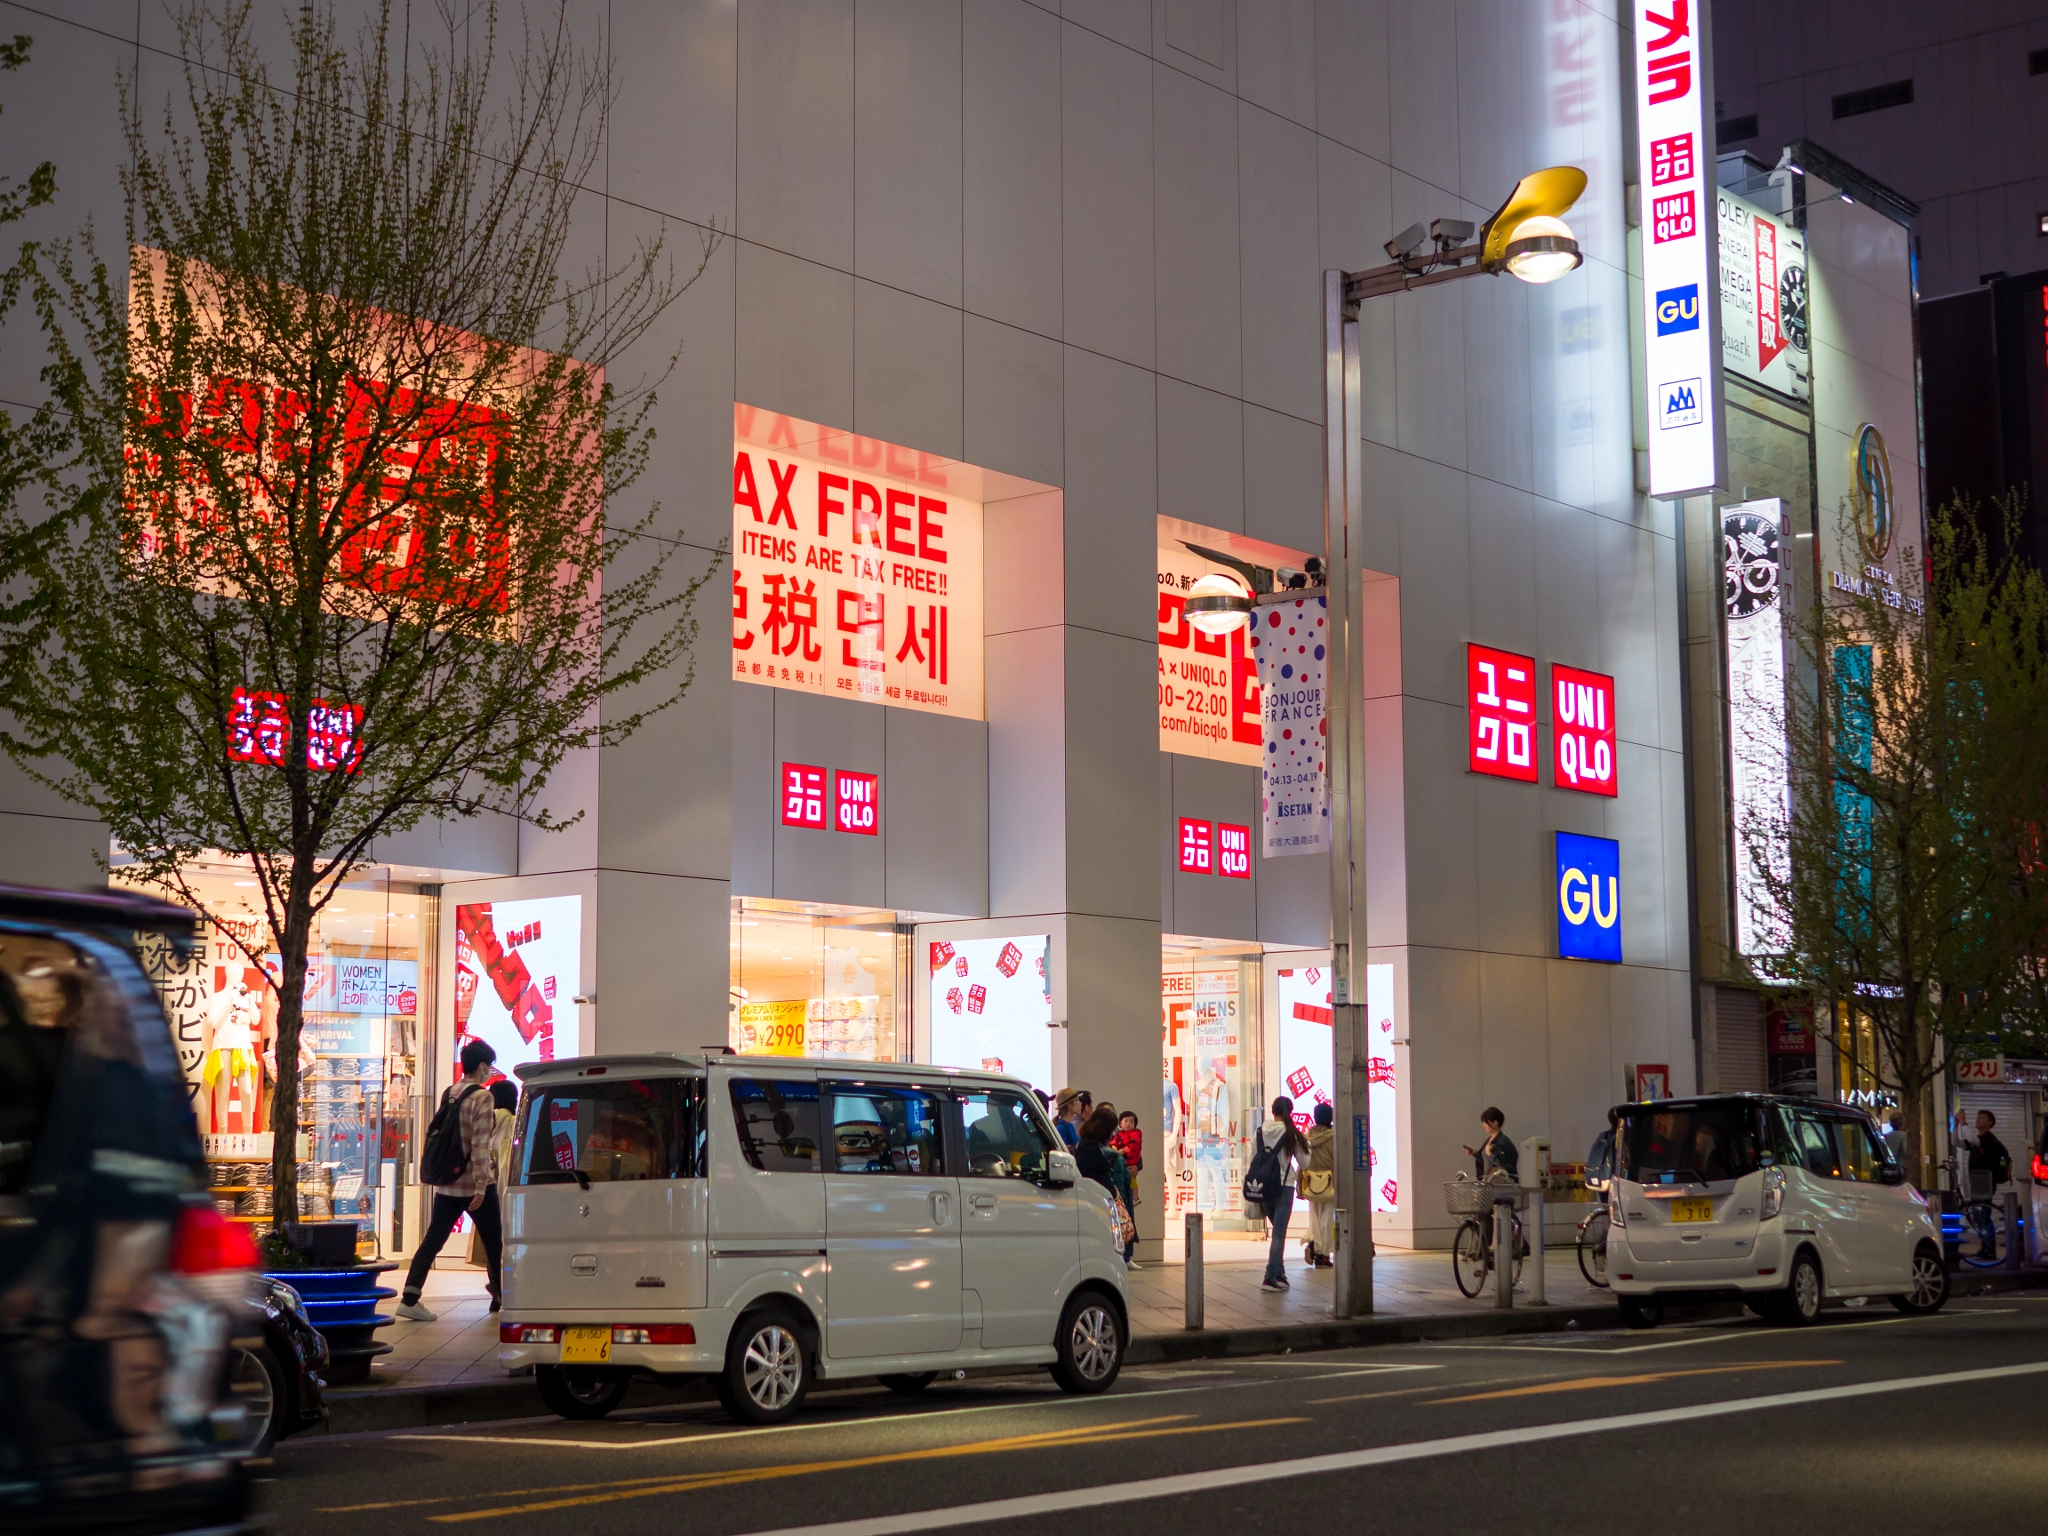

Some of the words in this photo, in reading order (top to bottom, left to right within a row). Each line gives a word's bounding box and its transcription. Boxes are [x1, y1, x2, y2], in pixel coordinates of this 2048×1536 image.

[1656, 196, 1689, 219] UNI
[1657, 215, 1692, 241] QLO
[1658, 296, 1698, 324] GU
[818, 471, 947, 564] FREE
[742, 531, 797, 564] ITEMS
[805, 545, 843, 574] ARE
[850, 554, 884, 583] TAX
[893, 563, 947, 596] FREE!!
[1181, 661, 1227, 688] UNIQLO
[837, 677, 853, 690] 모든
[885, 686, 901, 699] 세금
[1265, 689, 1321, 709] BONJOUR
[1265, 703, 1321, 724] FRANCE
[1558, 680, 1606, 731] UNI
[1560, 732, 1611, 784] QLO
[840, 778, 870, 802] UNI
[840, 803, 873, 828] QLO
[1221, 829, 1245, 851] UNI
[1221, 851, 1247, 874] QLO
[1560, 867, 1618, 929] GU
[215, 942, 238, 961] TO
[341, 965, 382, 979] WOMEN
[1196, 1000, 1236, 1018] MENS
[1196, 1026, 1227, 1035] T-SHIRTS
[1959, 1060, 1998, 1079] クスリ
